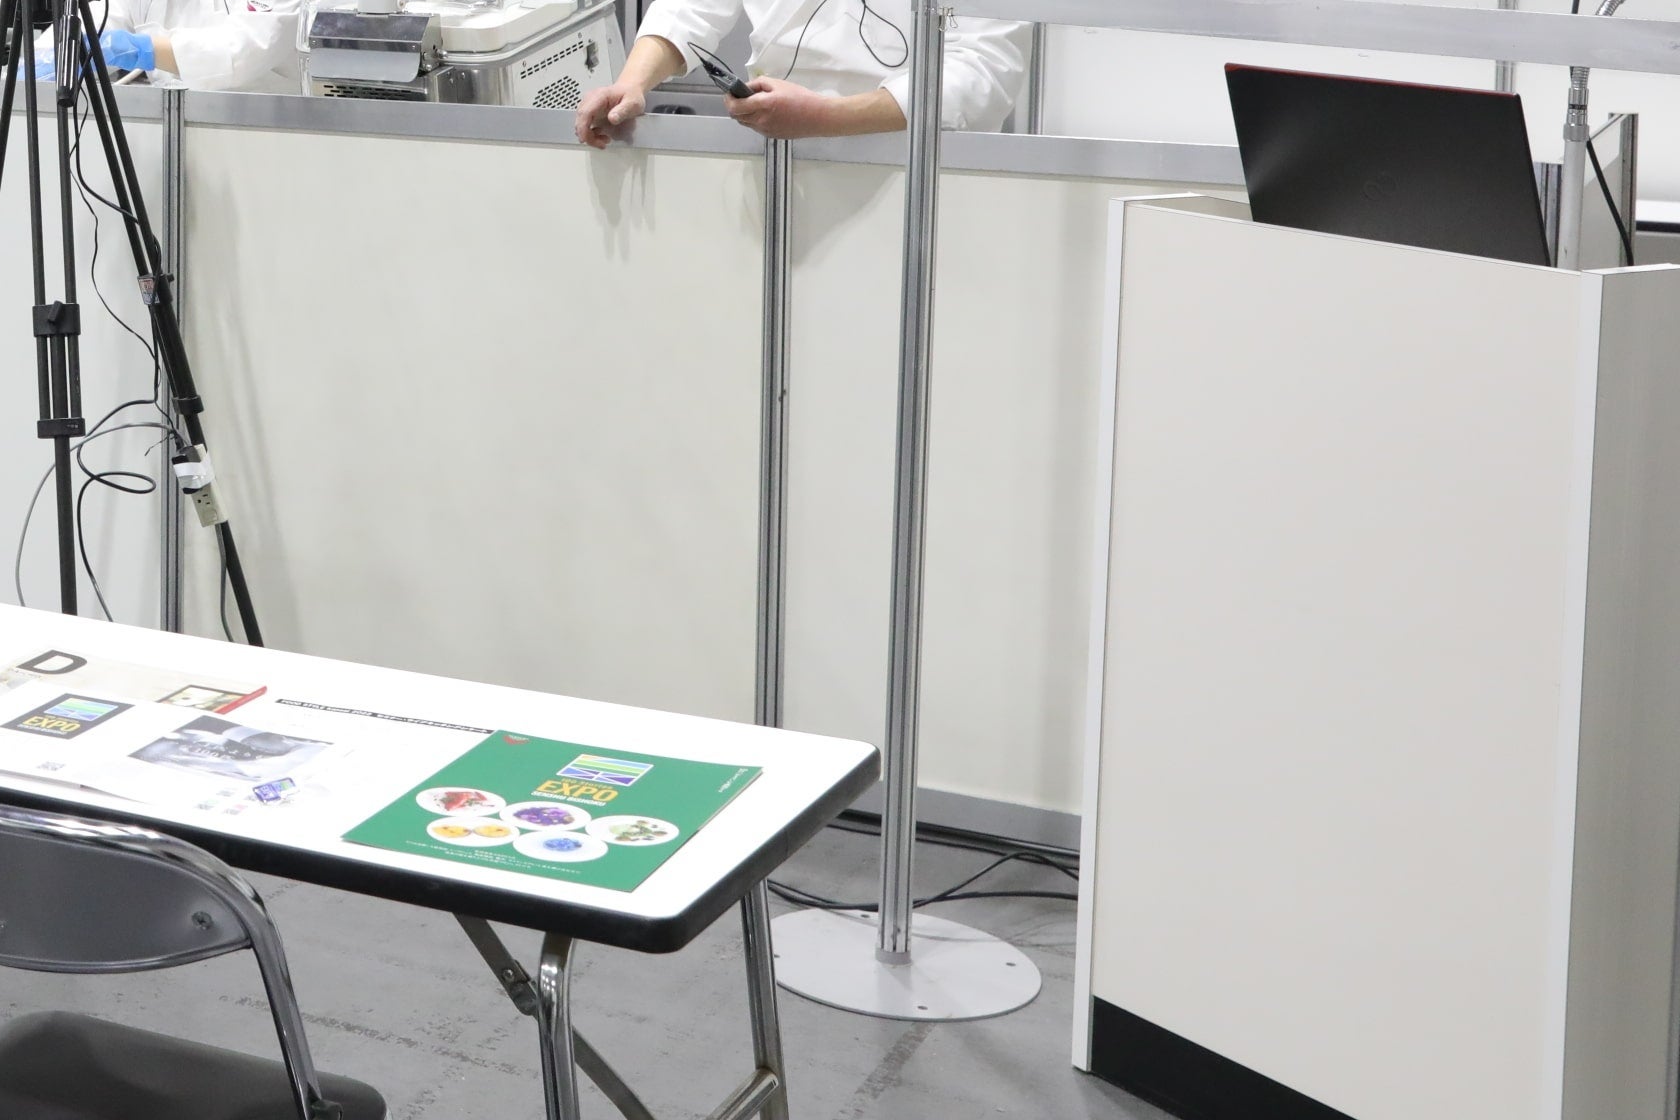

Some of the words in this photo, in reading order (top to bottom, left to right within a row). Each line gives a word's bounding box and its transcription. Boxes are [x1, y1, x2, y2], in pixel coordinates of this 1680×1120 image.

[15, 649, 88, 675] D
[21, 716, 82, 733] EXPO
[535, 779, 619, 802] EXPO
